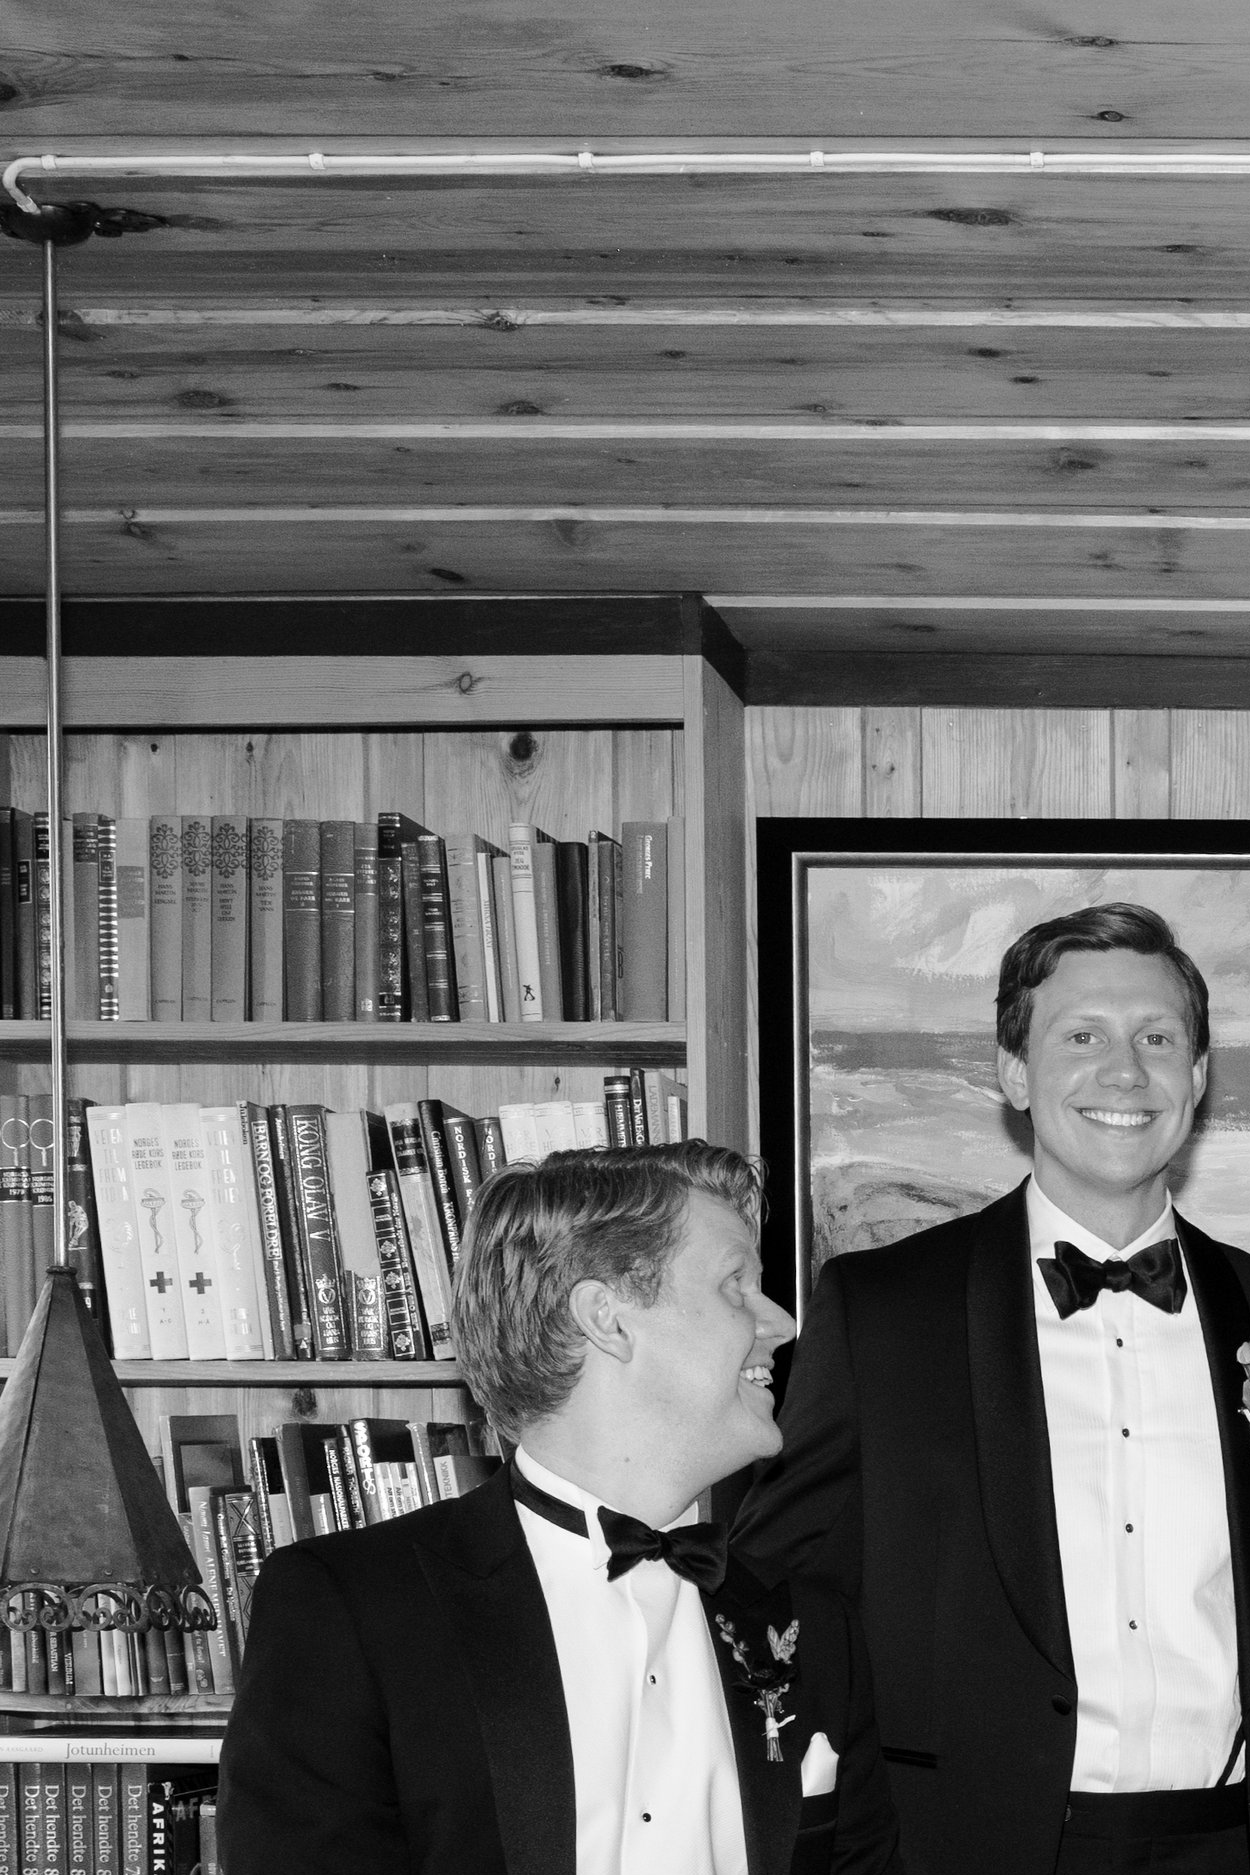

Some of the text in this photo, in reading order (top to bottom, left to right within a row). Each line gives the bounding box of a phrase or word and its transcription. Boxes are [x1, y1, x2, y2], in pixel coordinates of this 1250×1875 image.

[131, 1148, 164, 1159] RØDE KORS
[133, 1138, 160, 1148] NORGES
[171, 1148, 205, 1160] RØDE KORS
[173, 1139, 200, 1149] NORGES
[253, 1125, 272, 1159] BARN
[134, 1160, 162, 1170] LEGEBOK
[174, 1161, 202, 1171] LEGEBOK
[258, 1164, 273, 1184] OG
[296, 1119, 331, 1242] KONG OLAV V
[260, 1188, 280, 1256] FORELDRE
[329, 1450, 349, 1529] NORGES NASJONALPARKER
[65, 1743, 156, 1759] Jotunheimen
[24, 1784, 40, 1812] Det
[45, 1784, 60, 1812] Det
[72, 1785, 86, 1812] Det
[98, 1785, 113, 1812] Det
[127, 1784, 142, 1811] Det
[25, 1815, 43, 1862] hendte
[45, 1815, 60, 1862] hendte
[72, 1815, 87, 1863] hendte
[98, 1815, 112, 1864] hendte
[127, 1815, 141, 1862] hendte
